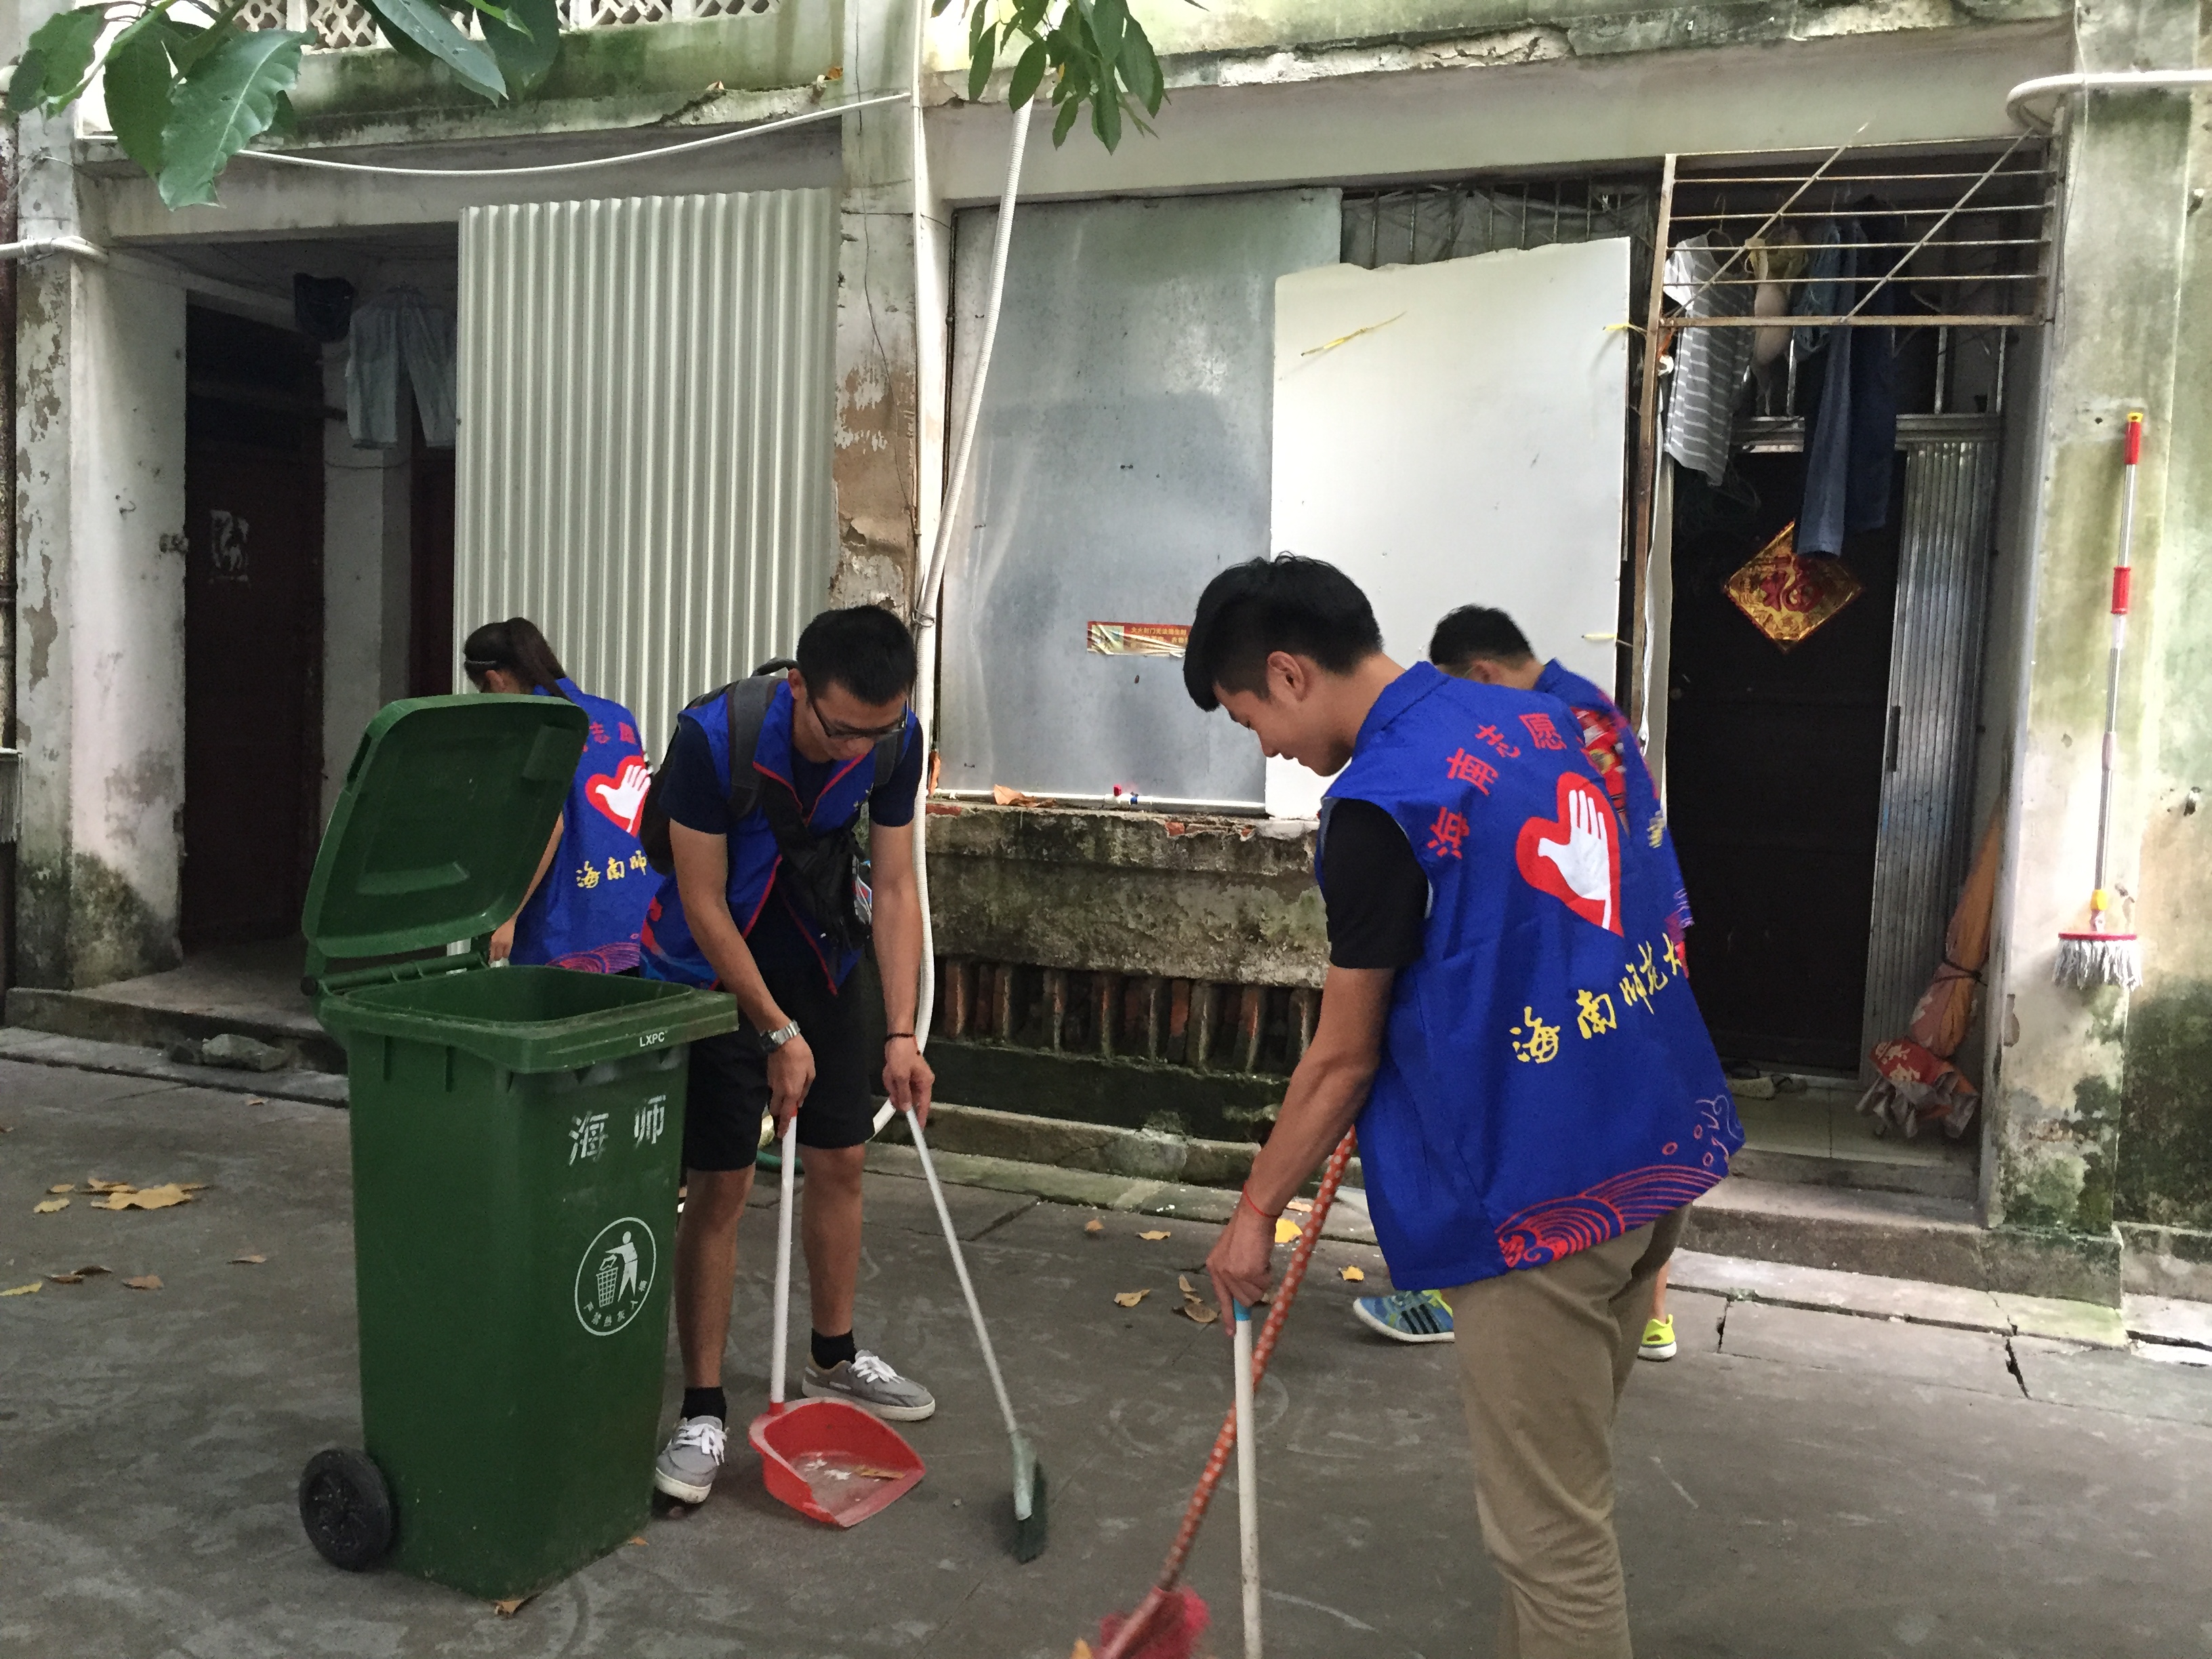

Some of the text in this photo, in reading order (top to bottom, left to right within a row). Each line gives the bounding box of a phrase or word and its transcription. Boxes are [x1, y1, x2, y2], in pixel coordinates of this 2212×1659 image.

[1427, 713, 1603, 859] 海南志愿
[639, 1031, 665, 1048] LXPC
